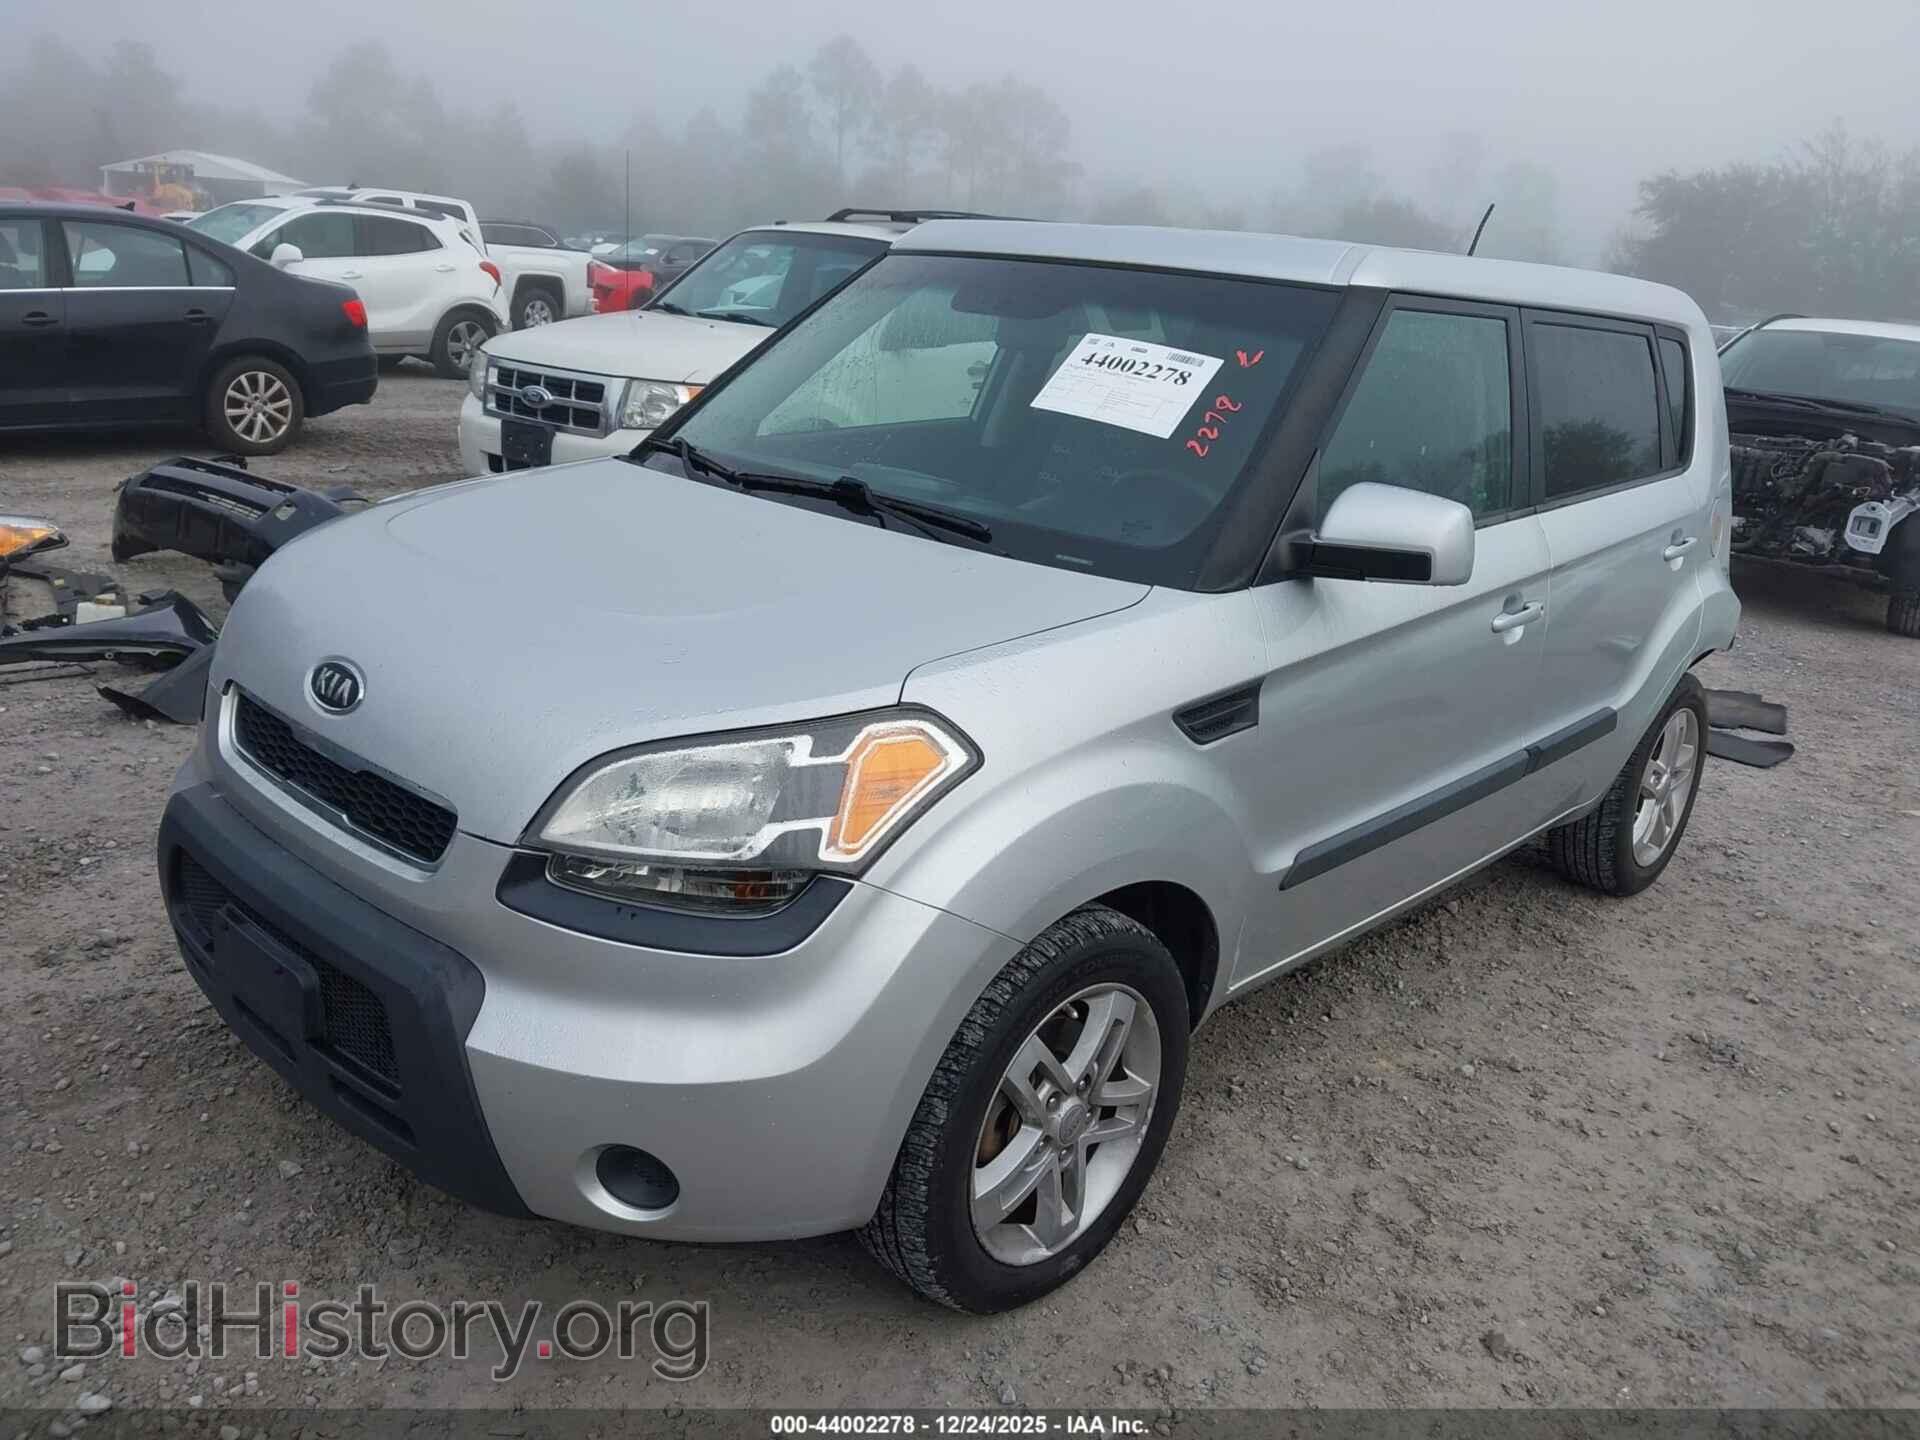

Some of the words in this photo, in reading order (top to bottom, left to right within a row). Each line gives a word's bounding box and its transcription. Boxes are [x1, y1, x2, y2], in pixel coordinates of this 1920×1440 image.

[1081, 352, 1193, 387] 44002278
[1186, 395, 1242, 457] 2278
[315, 666, 353, 707] KIA
